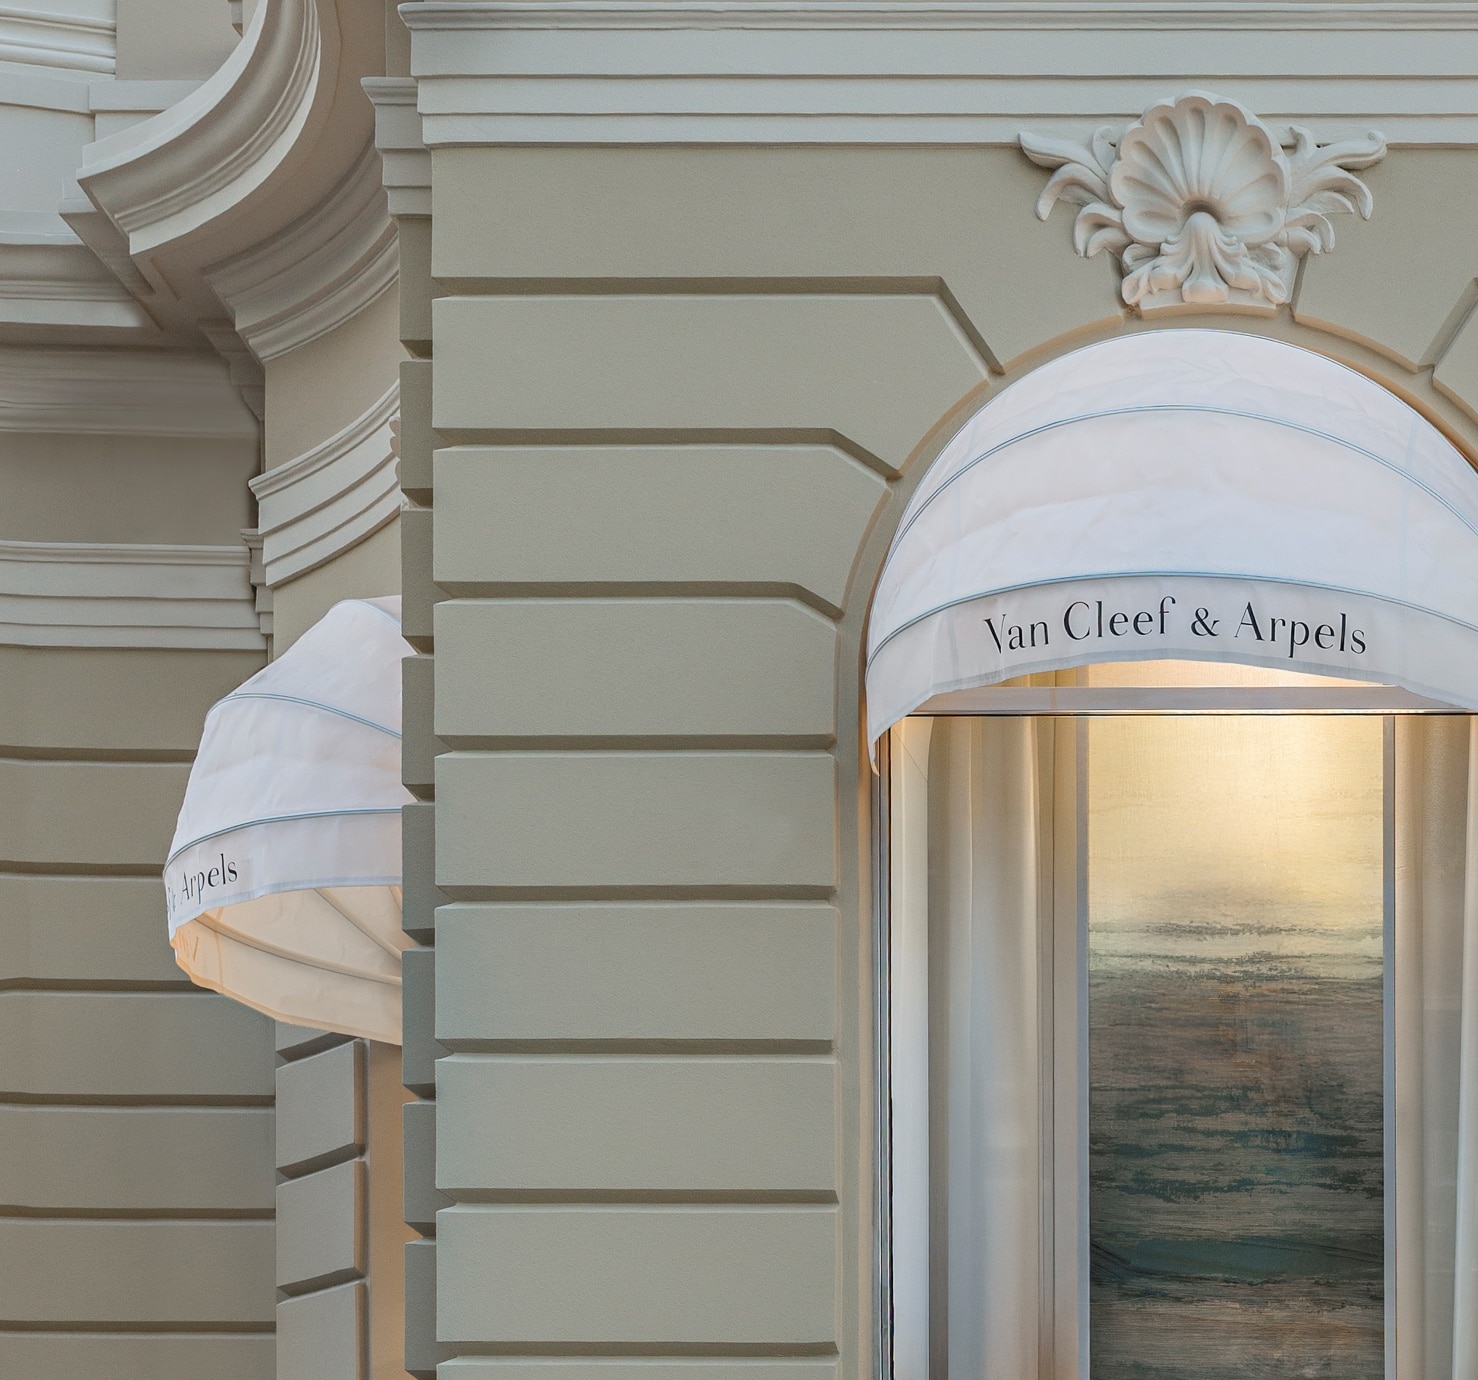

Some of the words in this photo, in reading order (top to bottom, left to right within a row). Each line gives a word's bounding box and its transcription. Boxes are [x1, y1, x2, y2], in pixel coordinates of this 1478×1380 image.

[983, 613, 1049, 655] Van
[1063, 595, 1176, 641] Cleef
[1190, 606, 1220, 638] &
[1233, 601, 1368, 659] Arpels
[180, 852, 238, 905] Arpels
